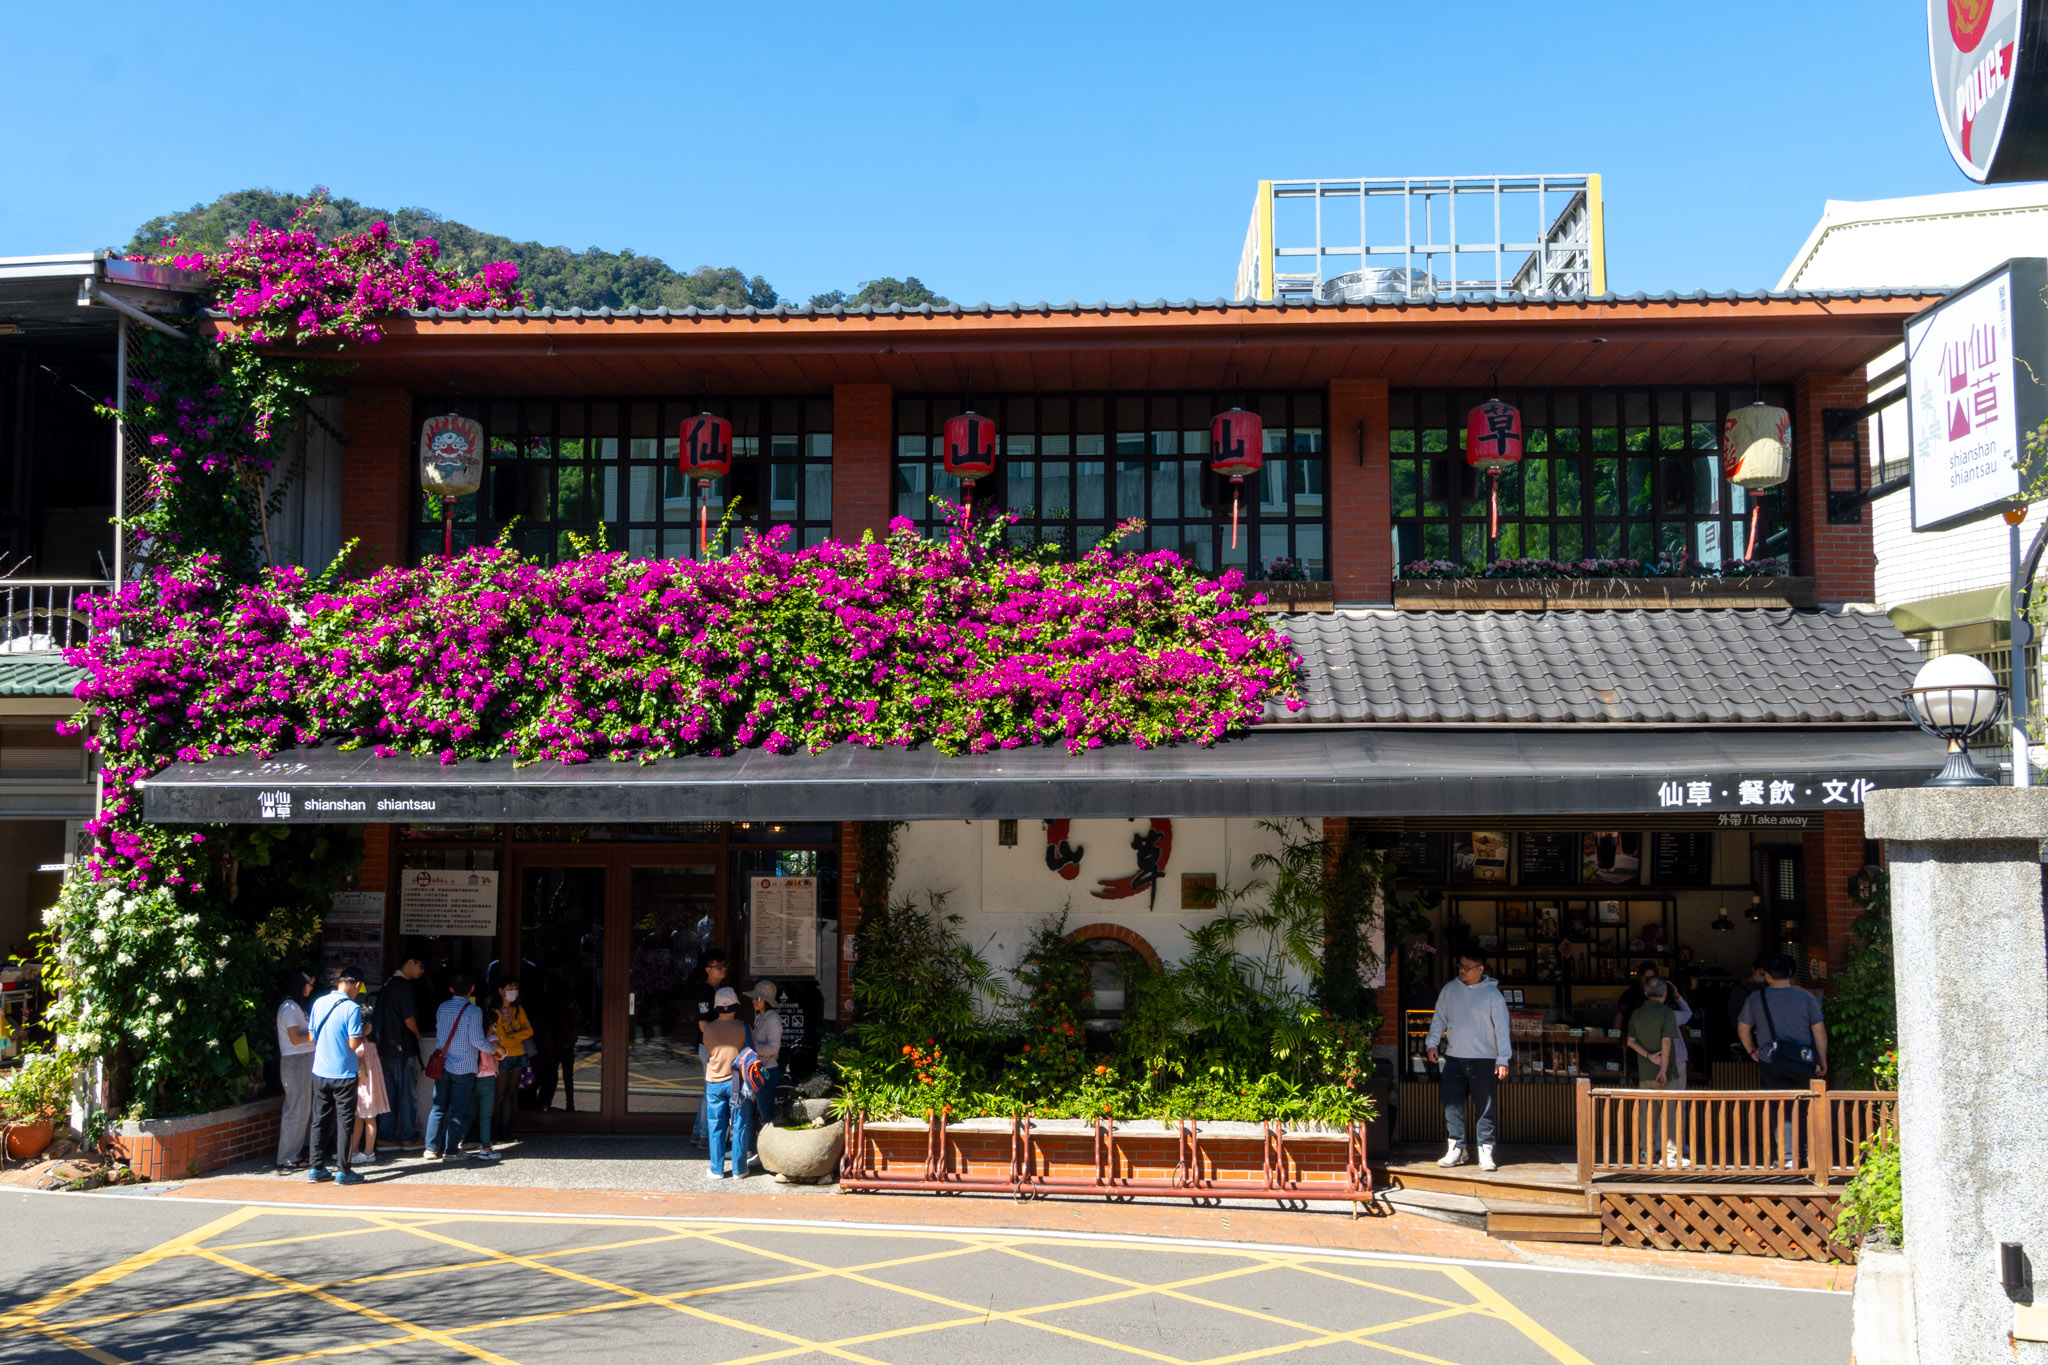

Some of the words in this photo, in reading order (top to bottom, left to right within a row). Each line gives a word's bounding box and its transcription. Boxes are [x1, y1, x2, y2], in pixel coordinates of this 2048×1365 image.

[1956, 39, 2006, 132] POLICE
[686, 420, 728, 466] 仙
[952, 419, 992, 466] 山
[1478, 403, 1520, 456] 草
[1949, 440, 1996, 469] shianshan
[1949, 460, 1997, 488] shiantsau
[304, 799, 366, 810] shianshan
[377, 798, 435, 810] shiantsau
[1718, 813, 1742, 826] 外帶
[1750, 814, 1777, 825] Take
[1779, 816, 1808, 827] away
